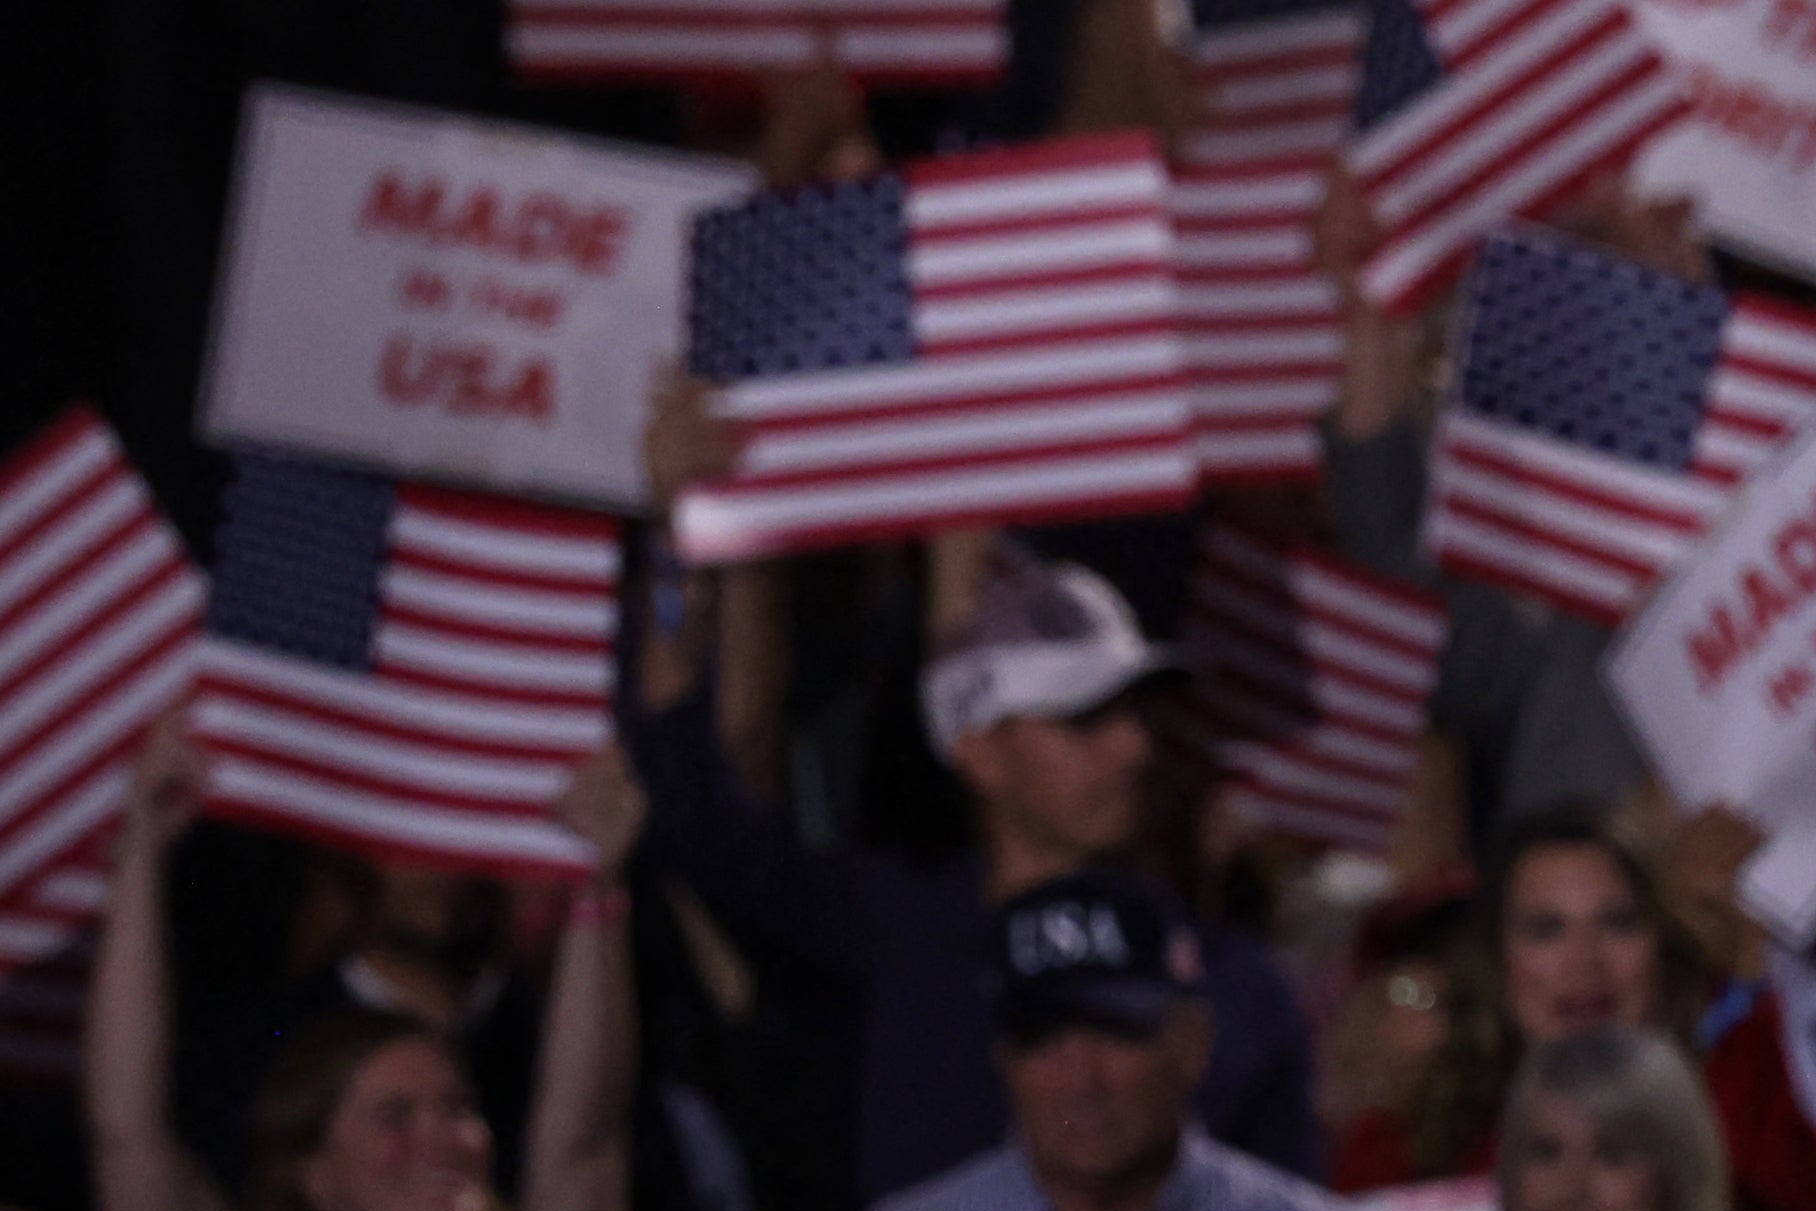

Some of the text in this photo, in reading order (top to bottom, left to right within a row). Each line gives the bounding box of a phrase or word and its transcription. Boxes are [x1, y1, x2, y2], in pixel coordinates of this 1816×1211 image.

[360, 172, 630, 276] MADE
[377, 332, 557, 423] USA
[1006, 902, 1130, 976] USA
